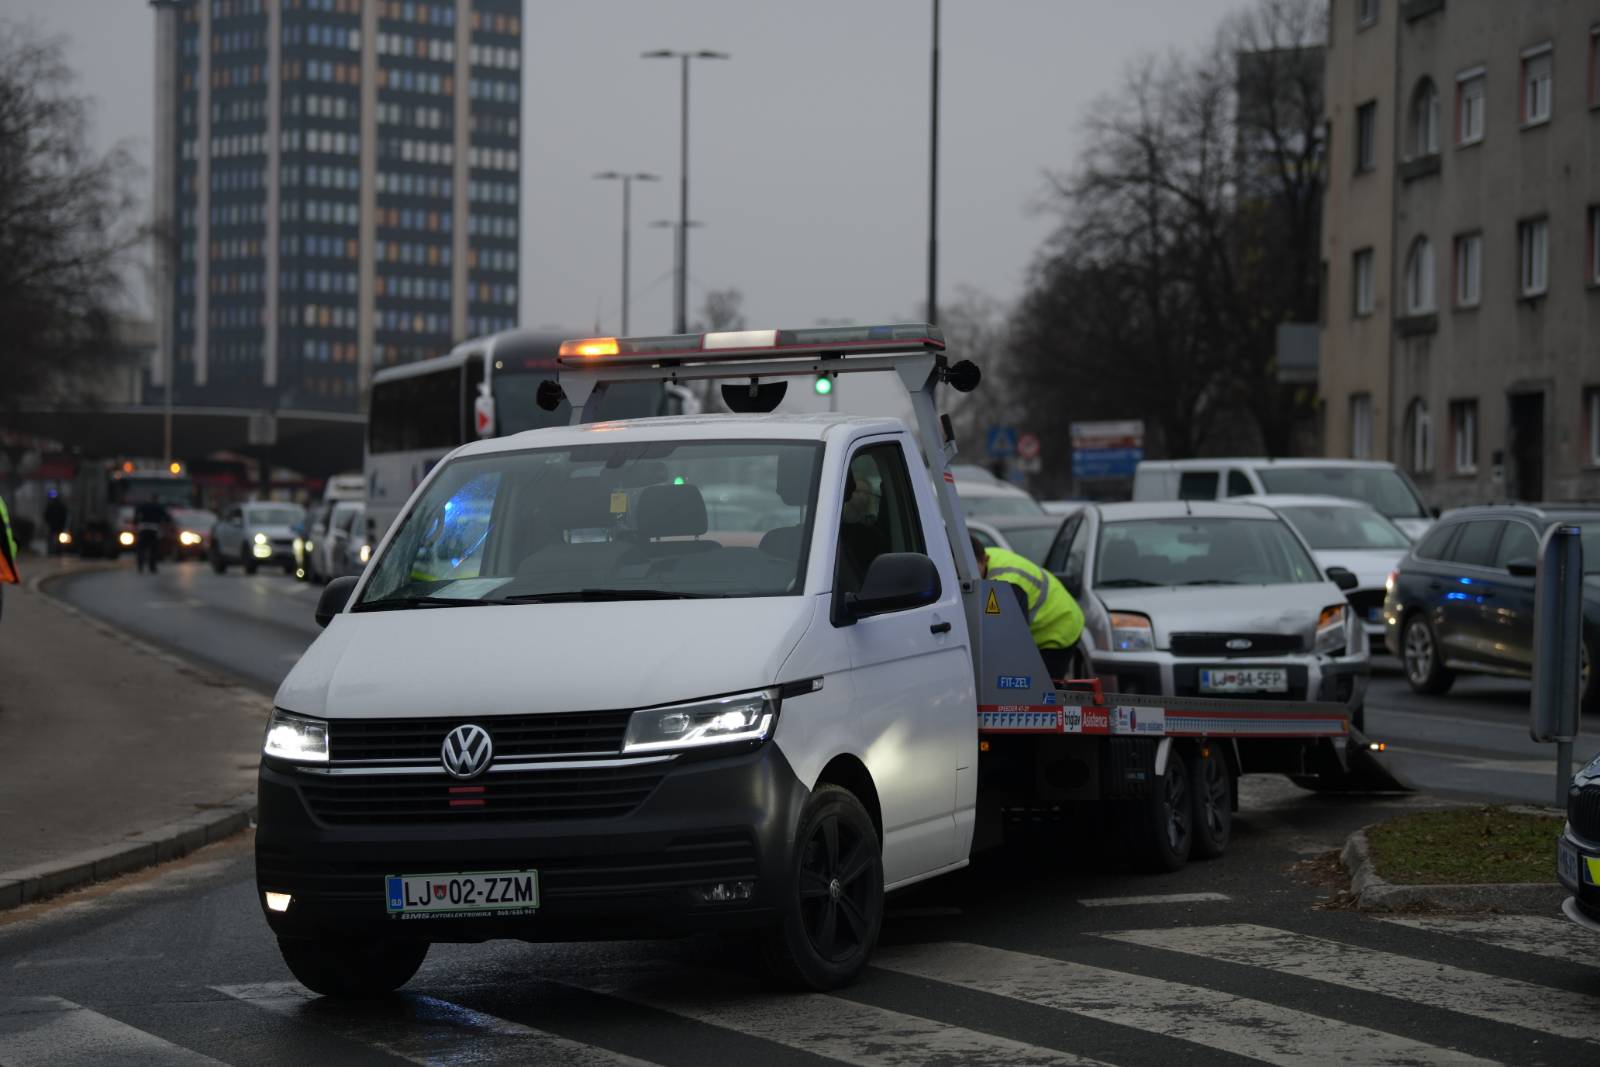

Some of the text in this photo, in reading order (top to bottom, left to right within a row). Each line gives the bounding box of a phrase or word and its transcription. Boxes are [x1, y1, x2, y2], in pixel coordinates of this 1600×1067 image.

[1000, 677, 1028, 688] FIT-ZEL
[1211, 670, 1226, 687] LJ
[1064, 711, 1080, 730] triglav
[1082, 712, 1108, 728] Asistenca
[405, 876, 533, 906] LJ 02-ZZM
[401, 912, 430, 920] BMS
[430, 911, 492, 919] AVTOELEKTRONIKA
